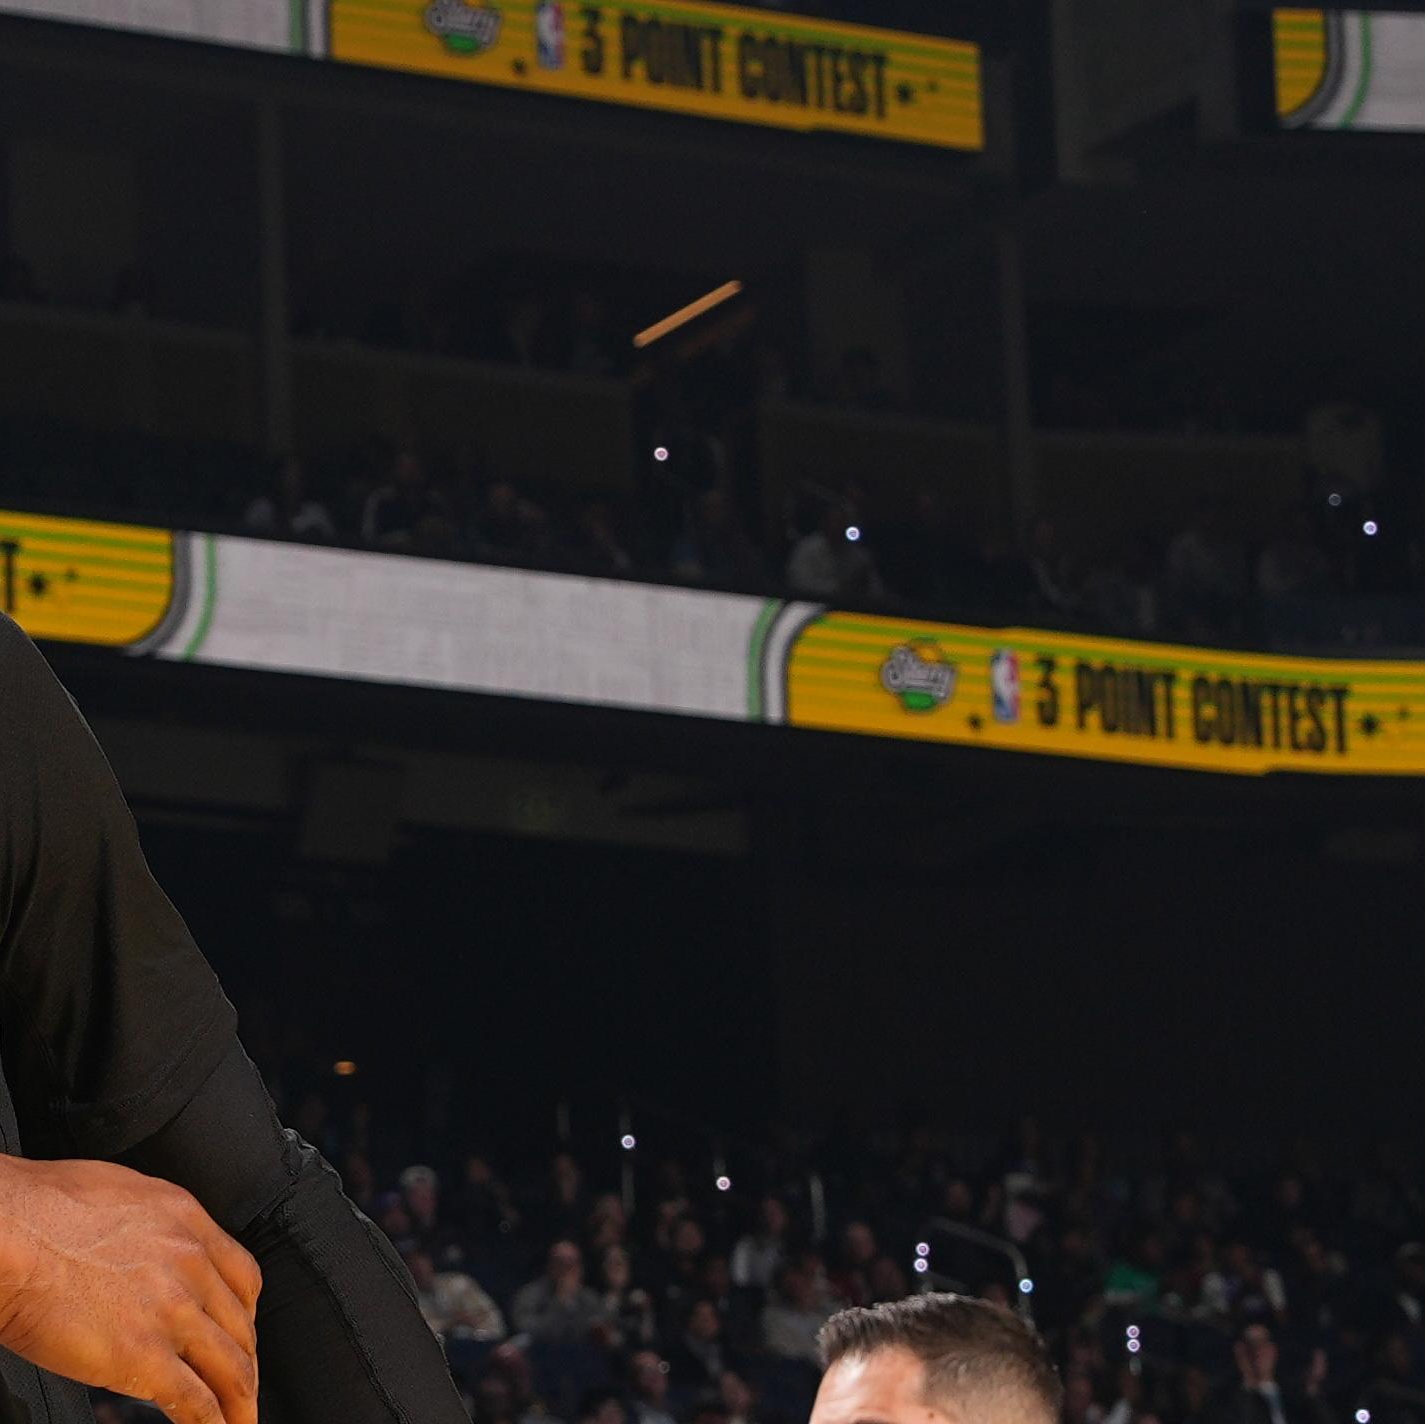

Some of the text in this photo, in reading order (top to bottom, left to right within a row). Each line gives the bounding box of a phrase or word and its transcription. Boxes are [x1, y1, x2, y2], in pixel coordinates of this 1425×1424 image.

[581, 6, 890, 119] 3 POINT CONTEST
[1036, 653, 1349, 756] 3 POINT CONTEST
